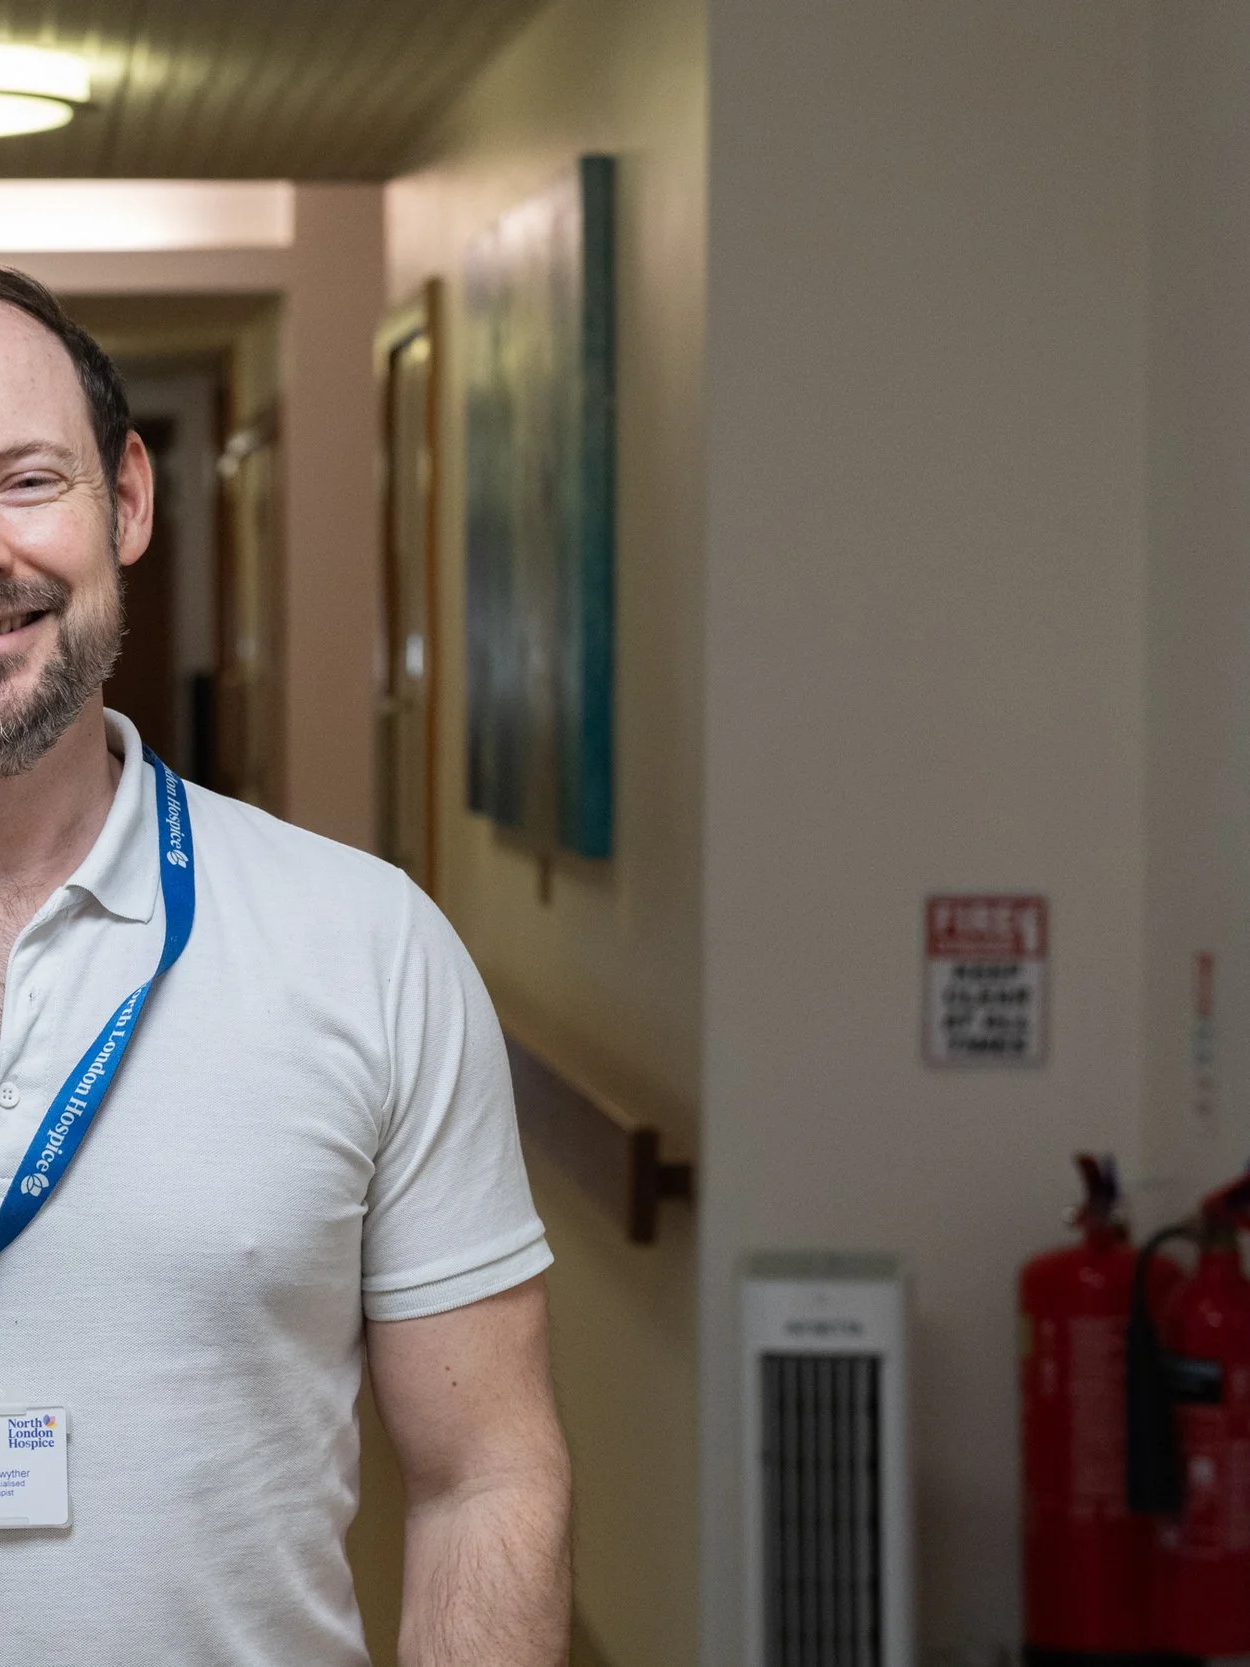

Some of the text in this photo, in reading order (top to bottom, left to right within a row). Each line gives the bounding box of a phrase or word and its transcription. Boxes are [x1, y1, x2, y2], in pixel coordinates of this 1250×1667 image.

[165, 796, 185, 849] Hospice
[36, 985, 147, 1173] orth London Hospice
[8, 1418, 42, 1428] North
[8, 1428, 53, 1438] London
[8, 1438, 55, 1450] Hospice
